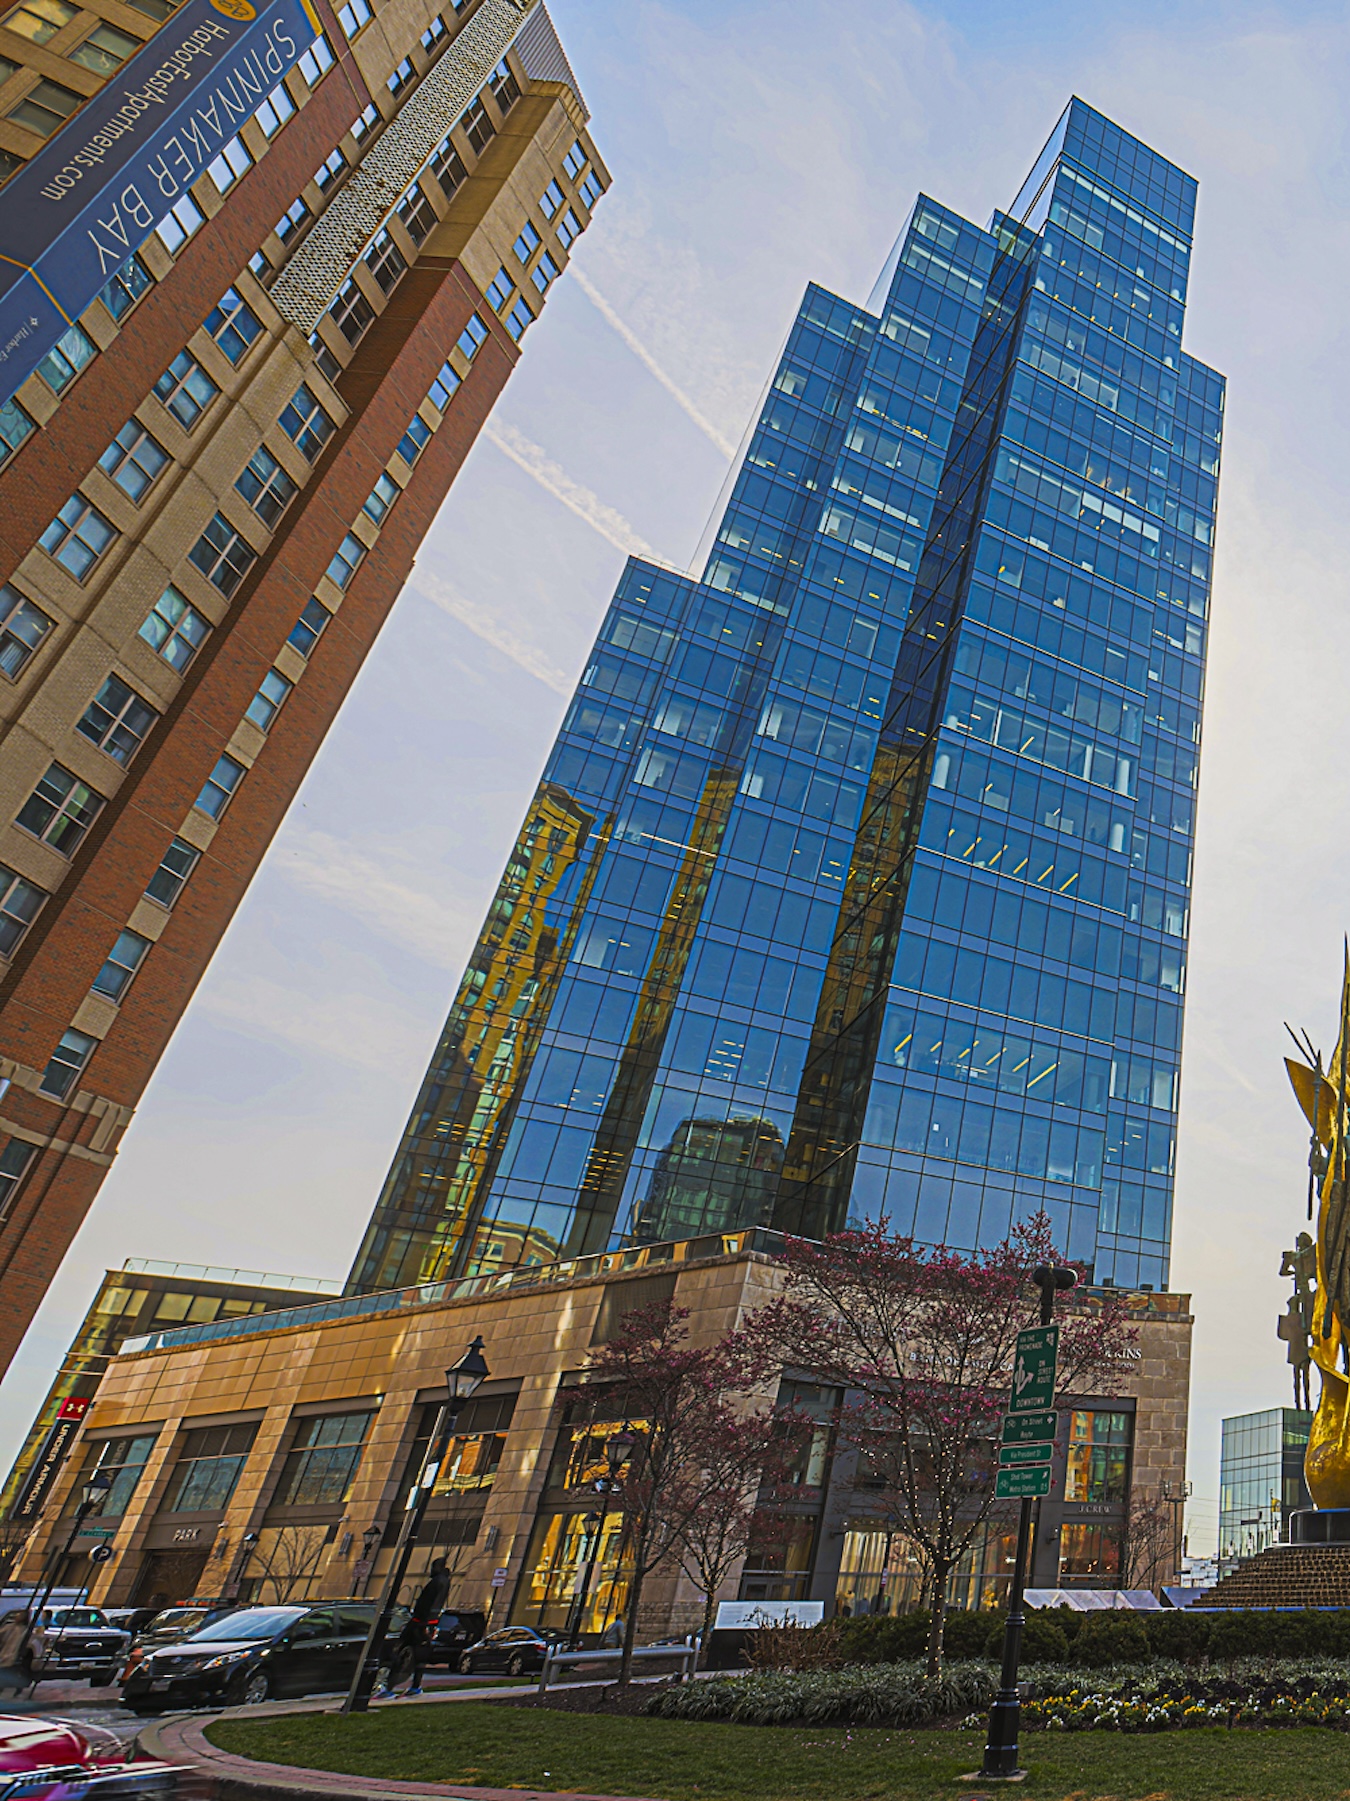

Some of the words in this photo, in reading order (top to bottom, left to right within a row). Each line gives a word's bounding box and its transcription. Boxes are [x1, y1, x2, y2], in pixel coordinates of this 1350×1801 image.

[40, 19, 230, 201] HarborEastApartments.com
[148, 18, 297, 198] SPINNAKER
[87, 183, 154, 275] BAY
[1015, 1397, 1045, 1408] DOWNTOWN
[1020, 1431, 1033, 1439] Route
[46, 1423, 72, 1462] UNDER
[1021, 1472, 1033, 1480] Tower
[21, 1463, 52, 1516] ARMOUR
[1009, 1485, 1020, 1493] Metro
[172, 1528, 201, 1542] PARK
[97, 1548, 109, 1559] P
